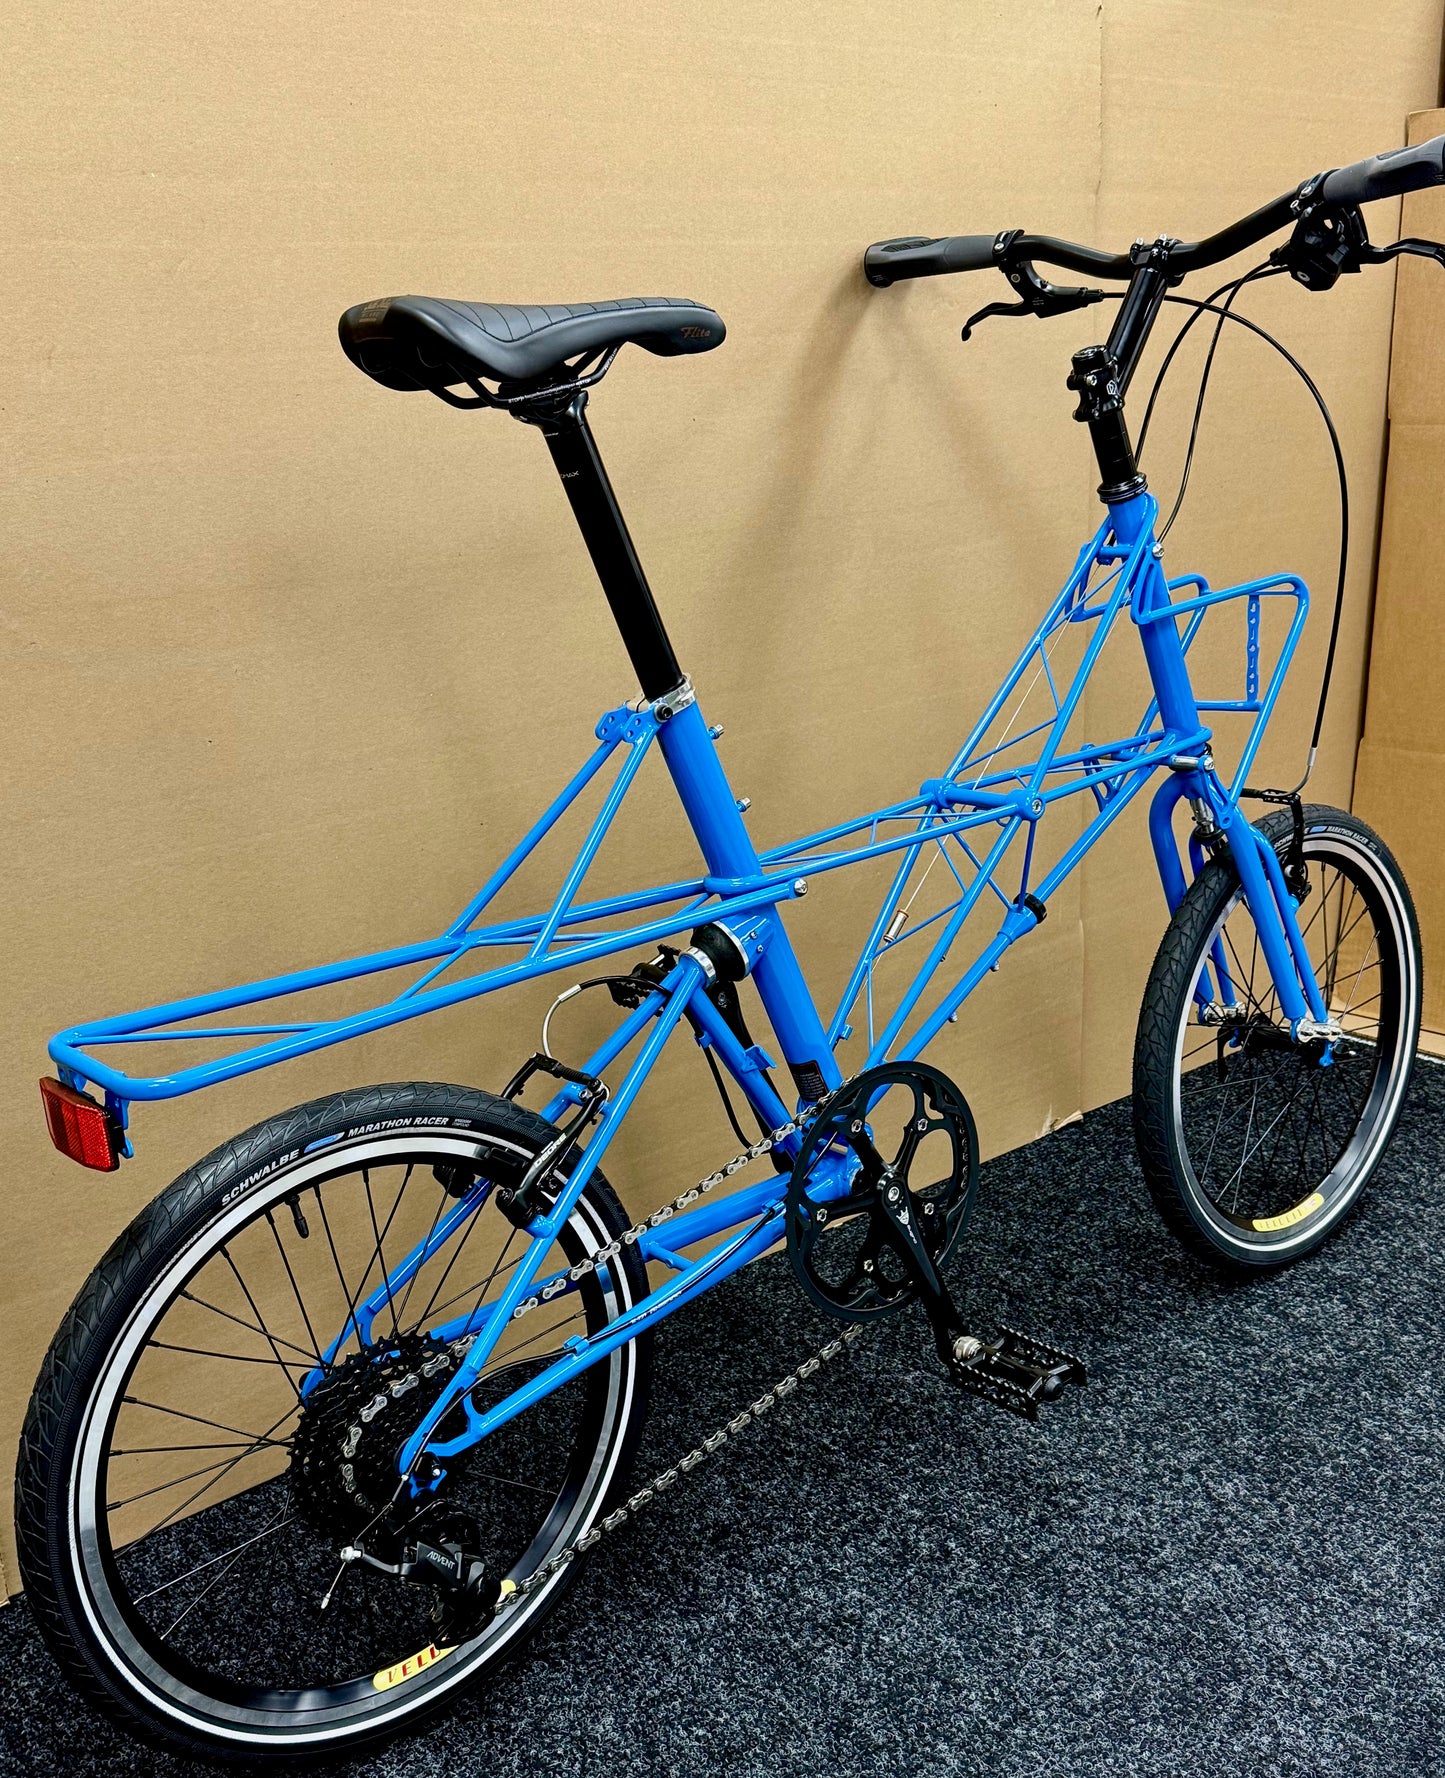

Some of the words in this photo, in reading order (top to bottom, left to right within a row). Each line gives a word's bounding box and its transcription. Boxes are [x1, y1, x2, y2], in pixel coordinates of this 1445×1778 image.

[221, 1148, 300, 1207] SCHWALBE
[347, 1117, 412, 1138] MARATHON
[412, 1116, 449, 1126] RACER
[426, 1550, 456, 1570] ADVENT
